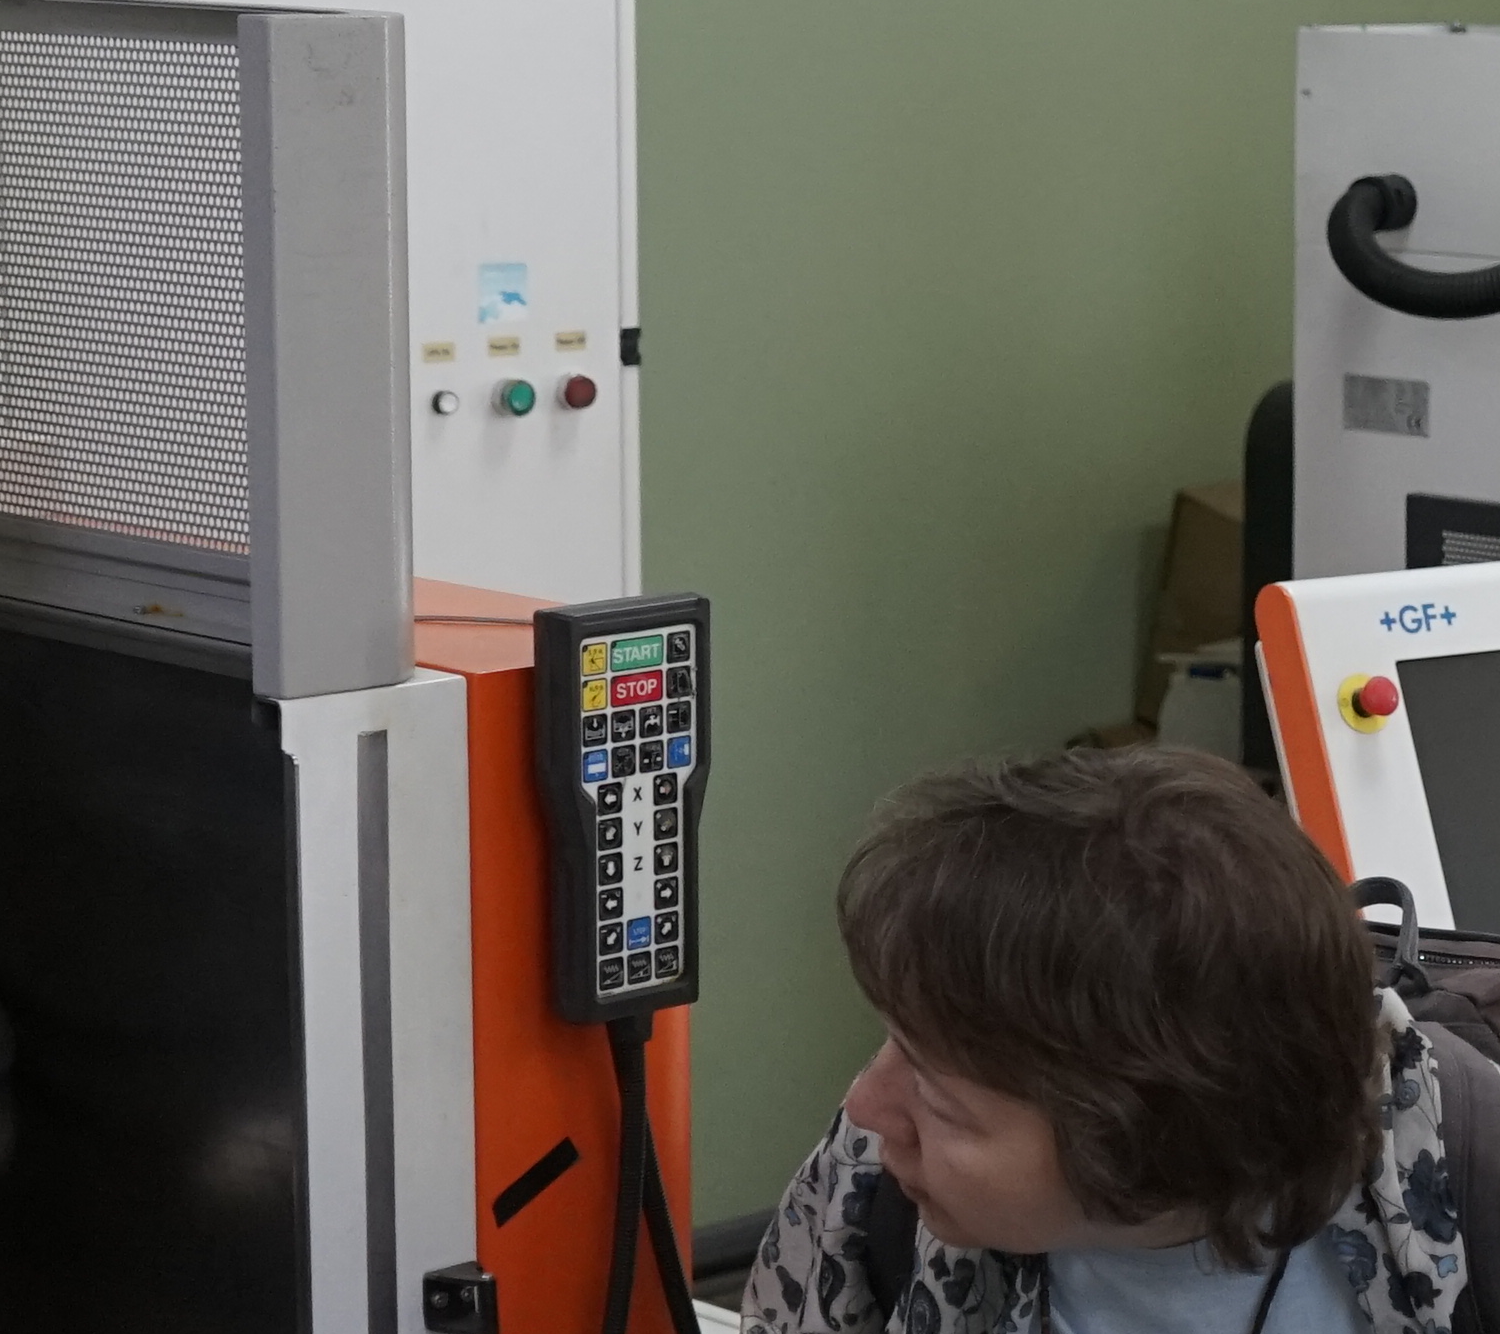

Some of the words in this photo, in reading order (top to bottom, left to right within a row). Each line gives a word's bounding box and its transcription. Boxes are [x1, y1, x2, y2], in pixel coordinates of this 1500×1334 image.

[612, 643, 660, 664] START
[616, 678, 658, 699] STOP
[633, 786, 643, 802] X
[633, 820, 643, 836] Y
[633, 856, 643, 872] Z
